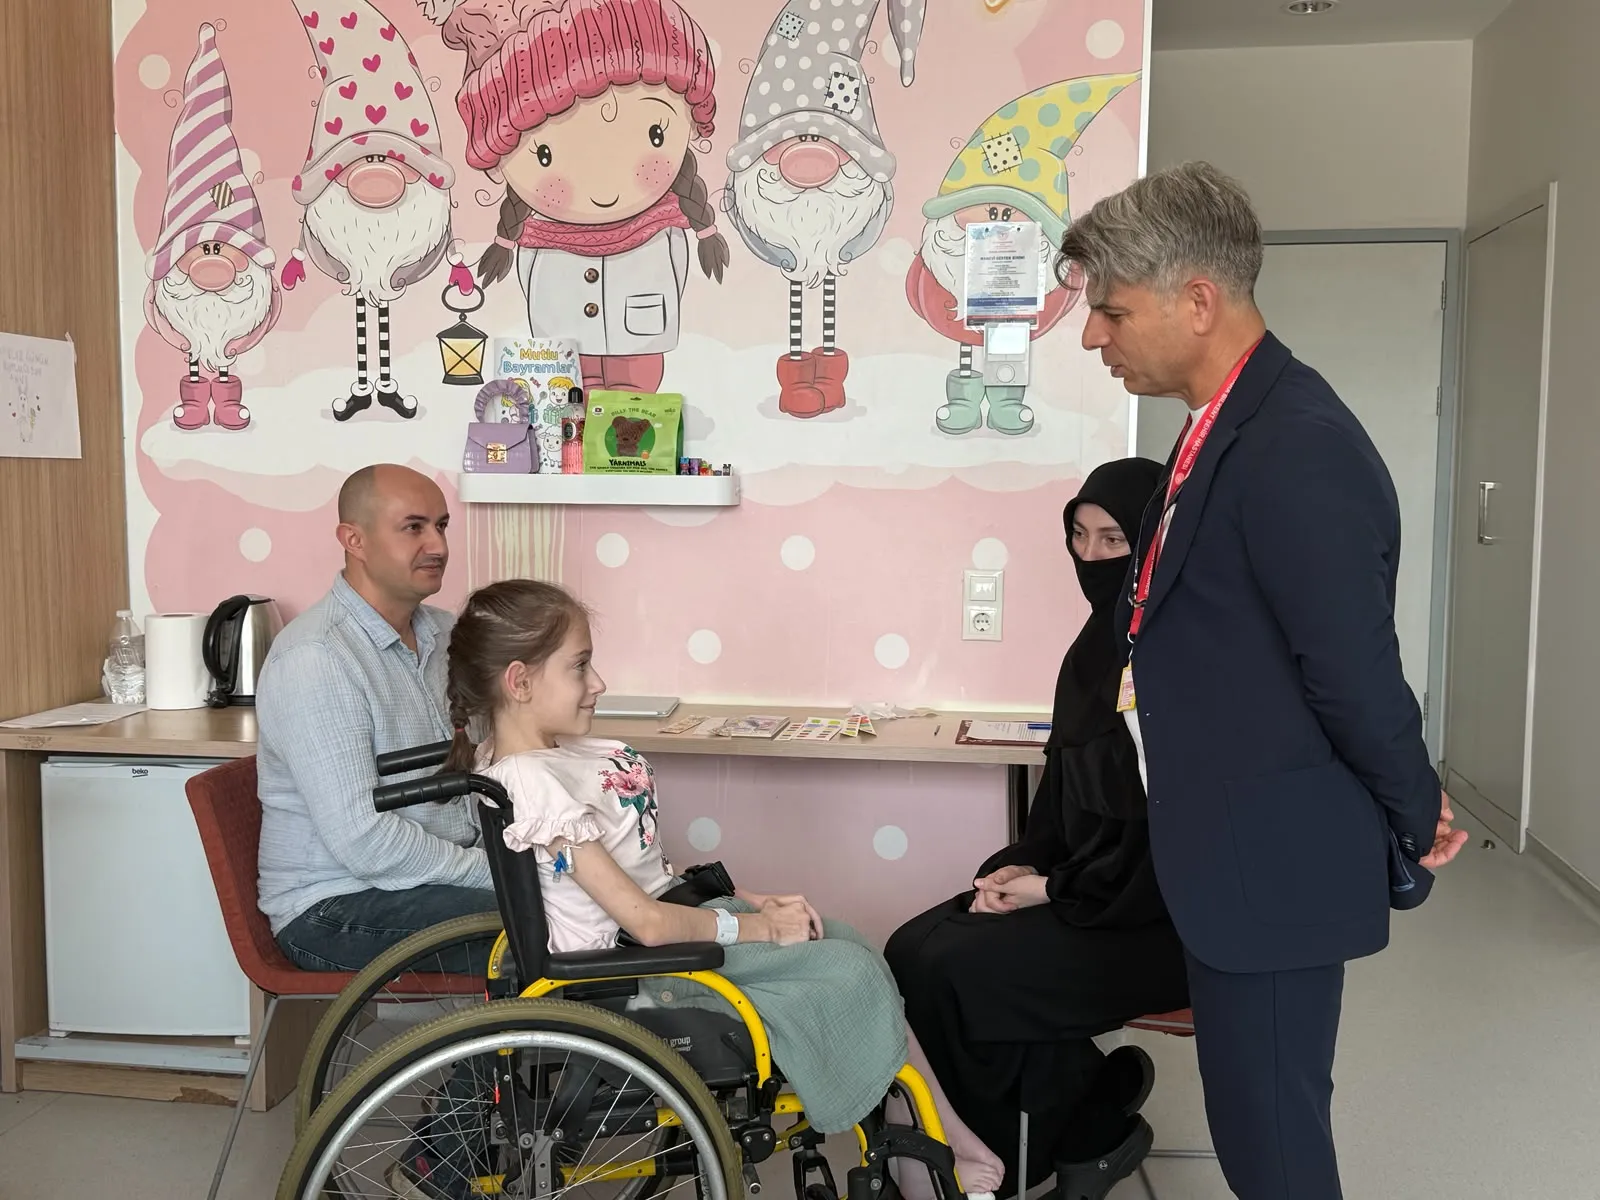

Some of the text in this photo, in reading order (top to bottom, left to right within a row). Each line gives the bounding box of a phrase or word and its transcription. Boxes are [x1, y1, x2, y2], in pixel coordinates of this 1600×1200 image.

[519, 348, 559, 360] Mutlu
[503, 361, 574, 376] Bayramlar
[641, 409, 657, 418] BEAR
[608, 459, 647, 467] YARNIMALS
[670, 1036, 691, 1047] group
